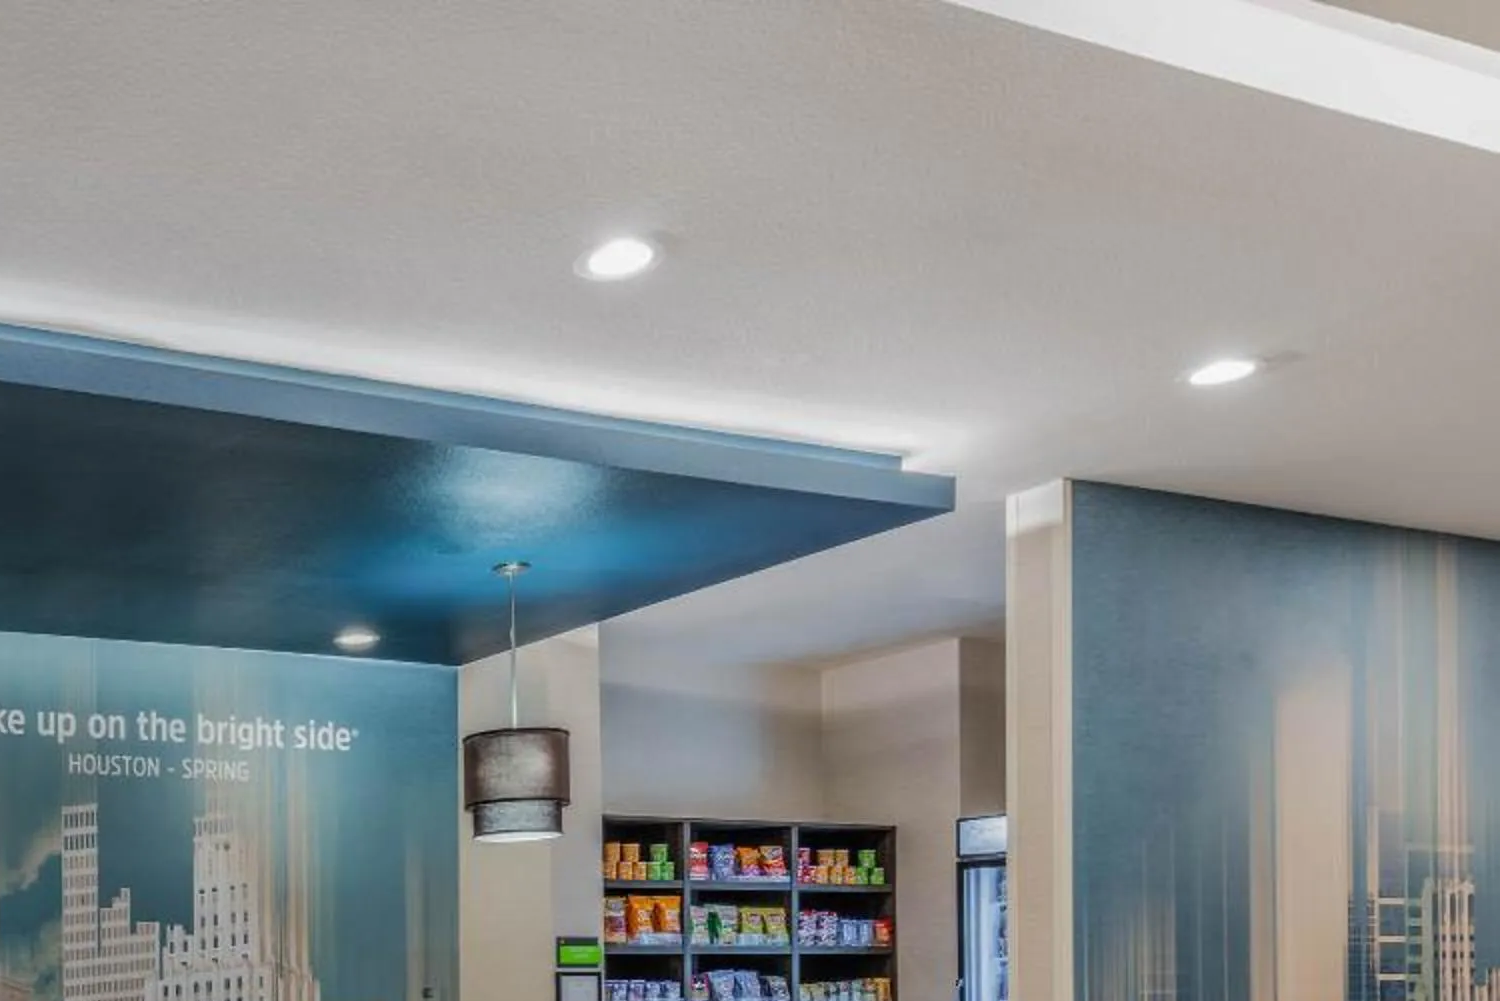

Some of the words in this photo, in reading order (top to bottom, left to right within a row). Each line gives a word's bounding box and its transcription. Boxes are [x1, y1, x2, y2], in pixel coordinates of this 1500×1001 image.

[38, 711, 76, 744] up
[88, 715, 126, 739] on
[137, 711, 186, 743] the
[198, 714, 285, 751] bright
[69, 753, 160, 778] HOUSTON
[181, 758, 249, 781] SPRING
